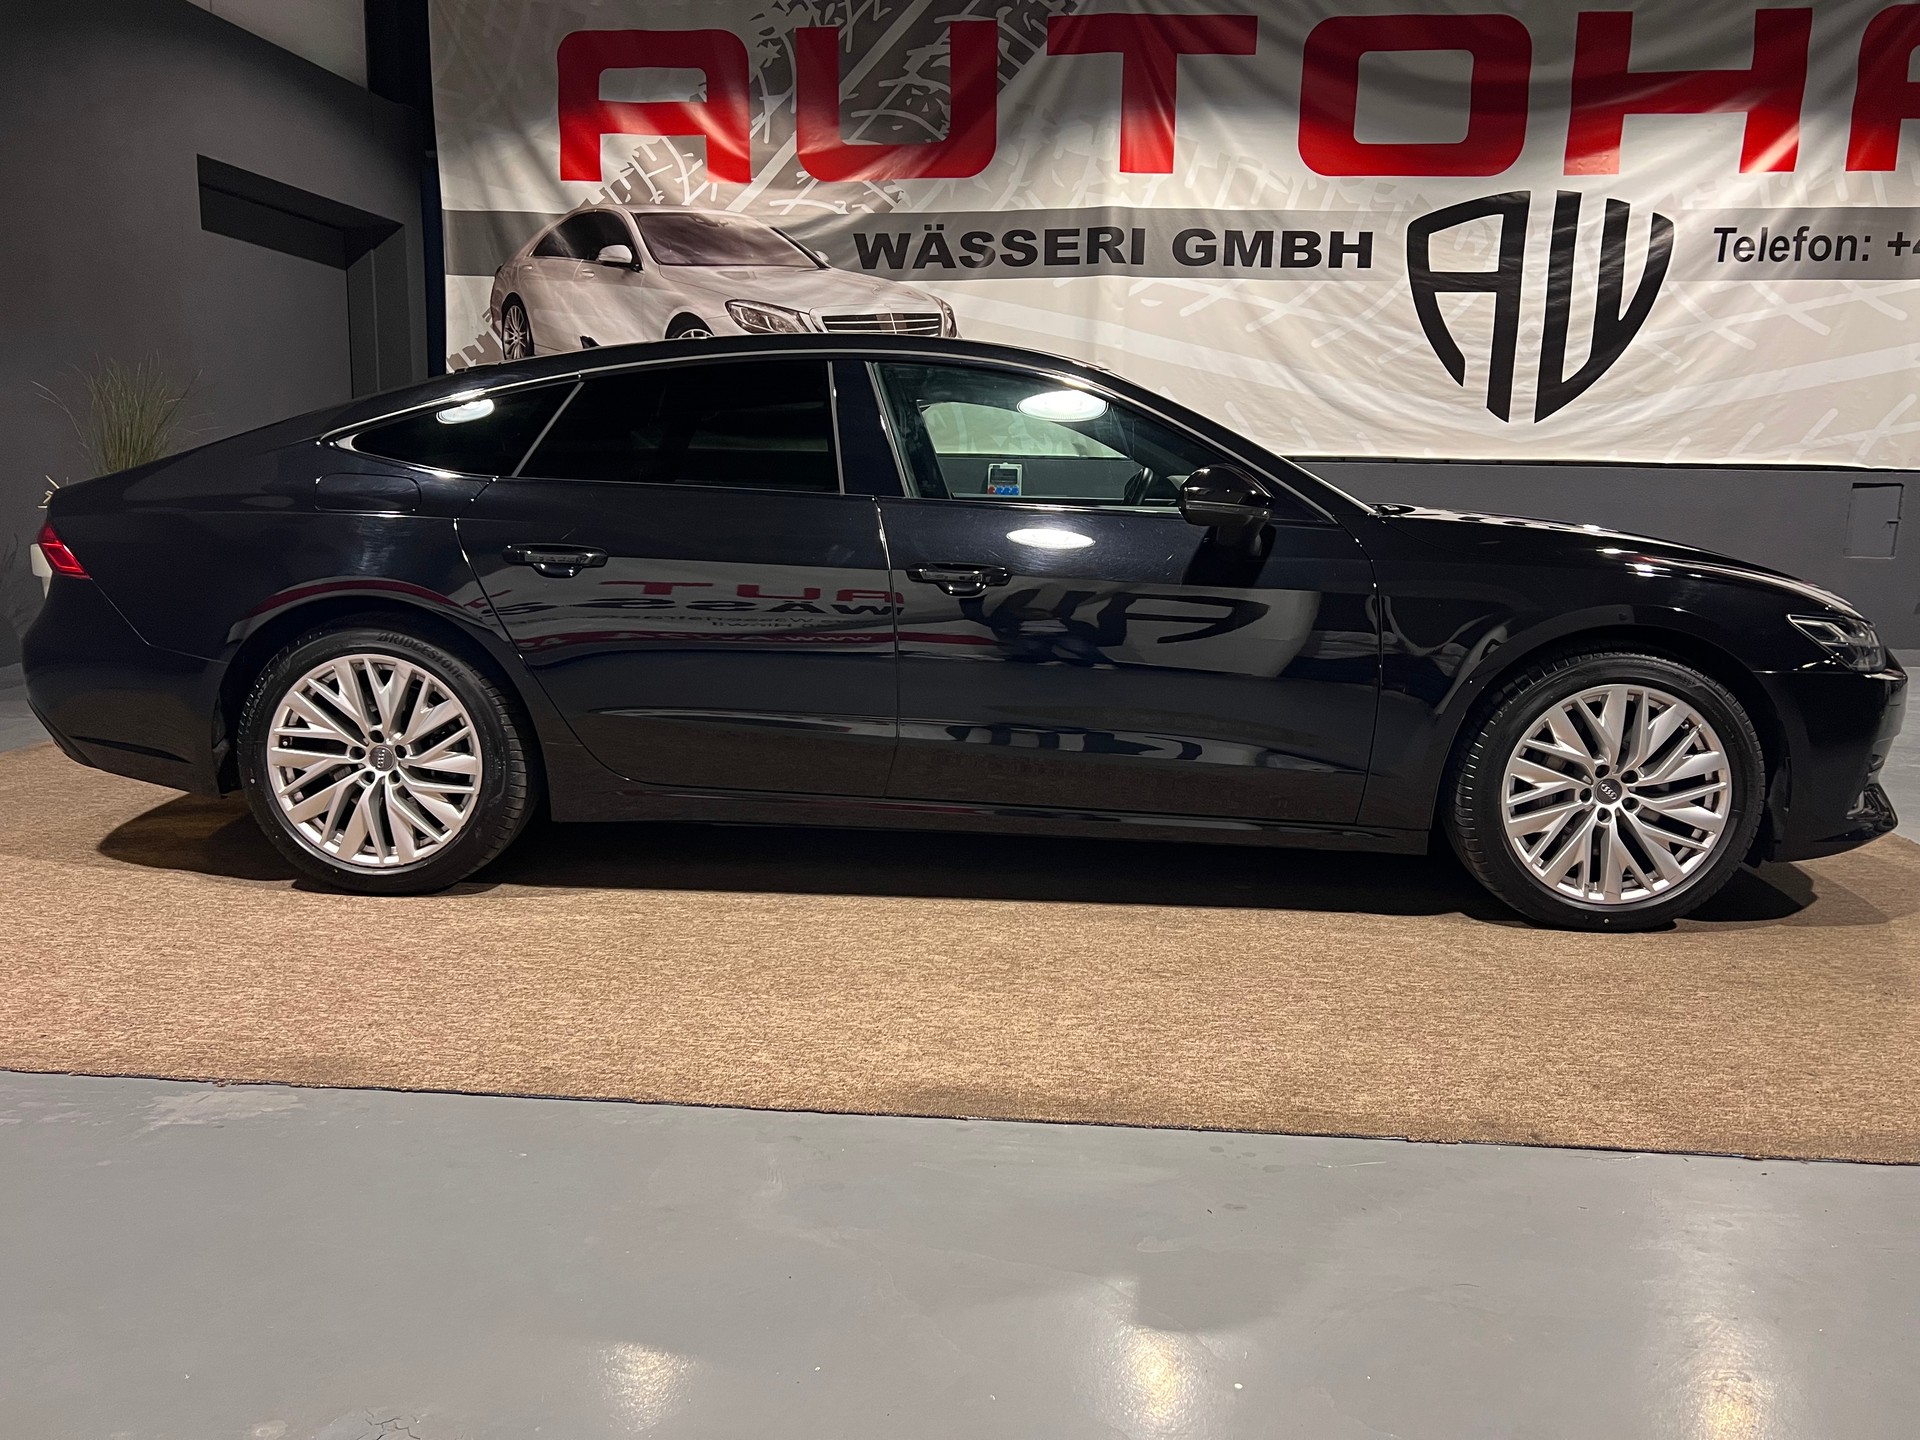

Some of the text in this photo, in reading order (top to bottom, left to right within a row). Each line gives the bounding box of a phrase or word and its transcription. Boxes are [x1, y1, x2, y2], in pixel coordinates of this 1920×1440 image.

[853, 224, 1374, 271] WÄSSERI GMBH
[1713, 226, 1871, 263] Telefon:
